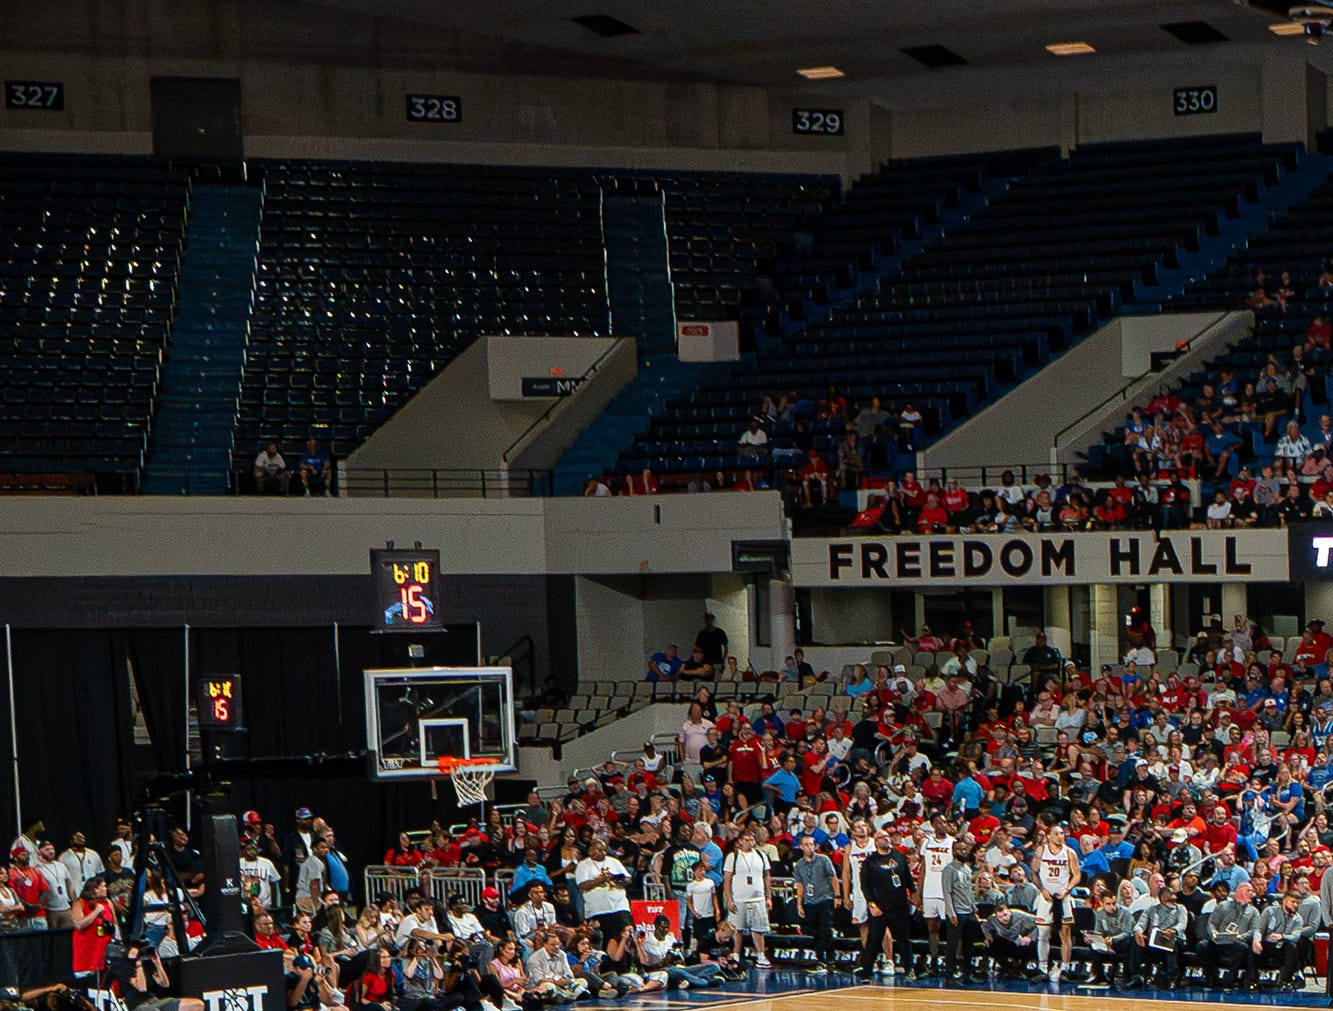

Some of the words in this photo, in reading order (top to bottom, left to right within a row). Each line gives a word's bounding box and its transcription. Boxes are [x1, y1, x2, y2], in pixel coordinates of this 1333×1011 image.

[10, 85, 58, 108] 327
[410, 97, 457, 120] 328
[1176, 89, 1215, 112] 330
[796, 110, 841, 134] 329
[828, 538, 1076, 581] FREEDOM
[1109, 536, 1252, 577] HALL
[392, 561, 430, 585] 6:10
[401, 585, 426, 623] 15
